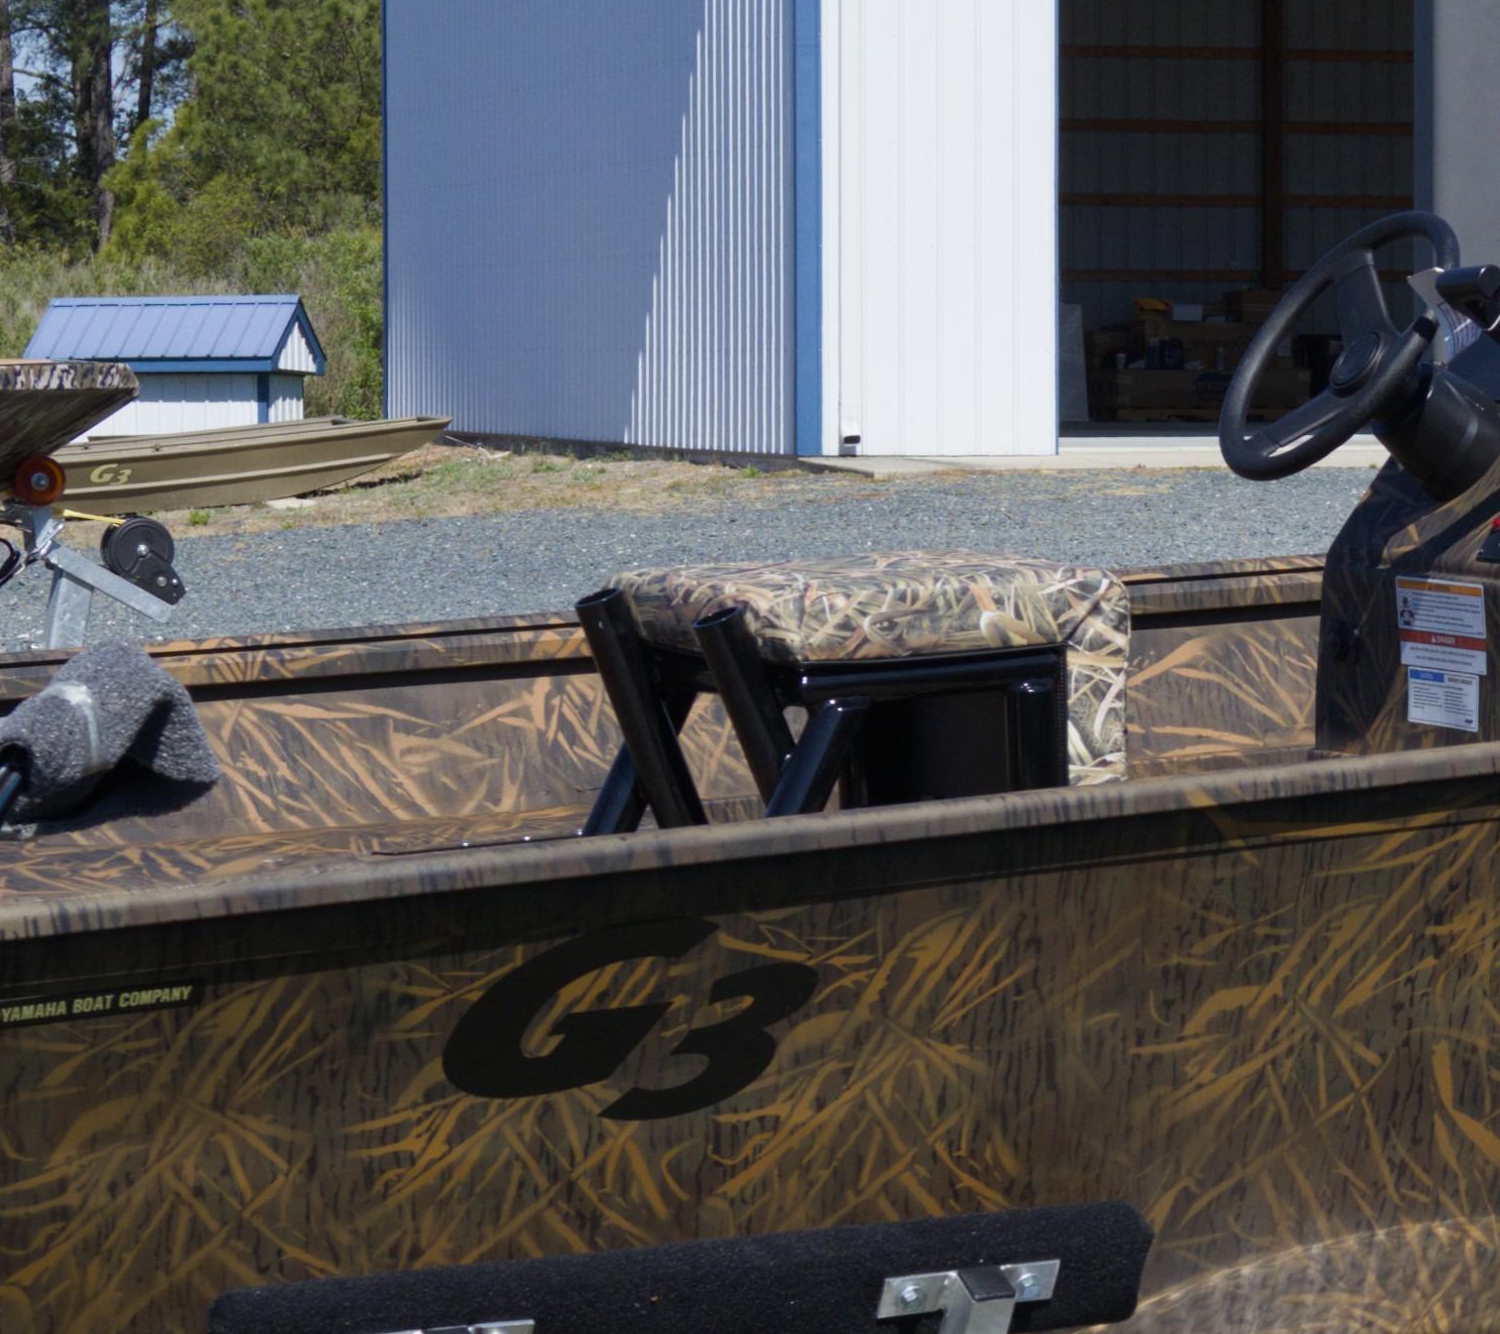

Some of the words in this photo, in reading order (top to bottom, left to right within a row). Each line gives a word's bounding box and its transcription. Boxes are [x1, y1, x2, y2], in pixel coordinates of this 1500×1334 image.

[90, 463, 132, 485] G3
[1, 1000, 67, 1023] YAMAHA
[72, 994, 115, 1014] BOAT
[118, 985, 193, 1008] COMPANY
[443, 915, 819, 1120] G3
